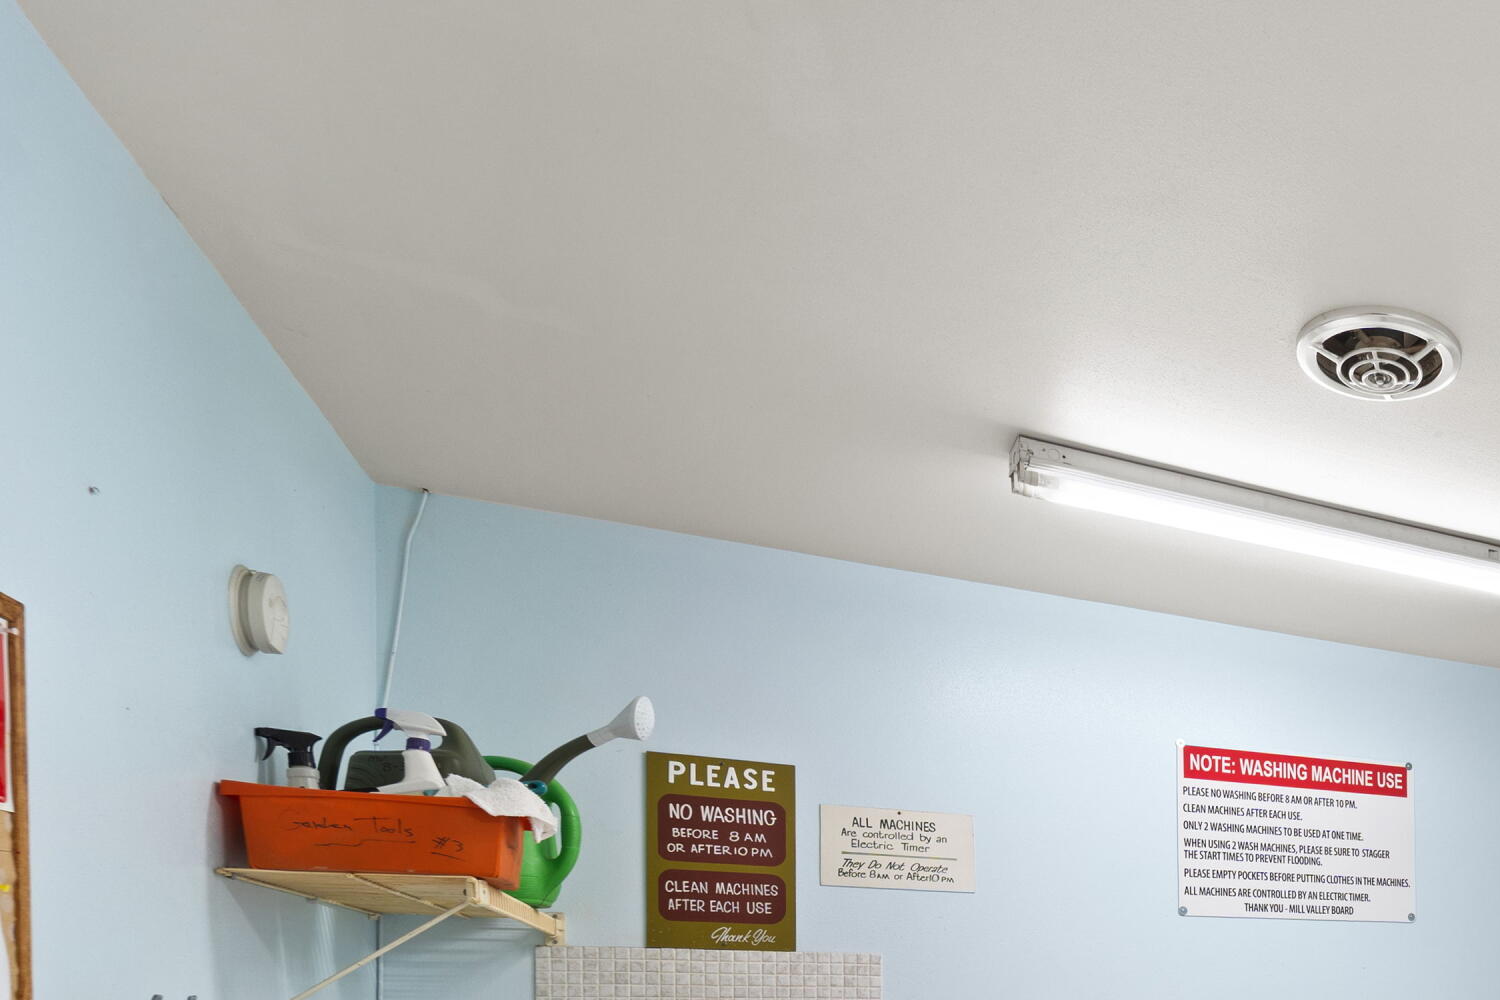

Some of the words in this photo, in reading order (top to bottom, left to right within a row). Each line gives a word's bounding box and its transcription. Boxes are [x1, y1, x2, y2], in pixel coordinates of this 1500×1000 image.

[668, 760, 776, 792] PLEASE
[1190, 753, 1235, 775] NOTE:
[1239, 758, 1308, 781] WASHING
[1311, 765, 1374, 787] MACHINE
[1377, 772, 1403, 789] USE
[1183, 786, 1209, 798] PLEASE
[1211, 789, 1222, 798] NO
[1222, 789, 1257, 801] WASHING
[1258, 792, 1284, 803] BEFORE
[1285, 795, 1290, 803] 8
[1291, 795, 1302, 804] AM
[1303, 796, 1313, 805] OR
[1314, 797, 1335, 807] AFTER
[1336, 799, 1344, 808] 10
[1345, 800, 1358, 809] PM.
[669, 803, 692, 820] NO
[700, 805, 777, 826] WASHING
[1183, 803, 1206, 814] CLEAN
[1208, 805, 1245, 816] MACHINES
[1246, 808, 1268, 818] AFTER
[1269, 810, 1287, 819] EACH
[1288, 811, 1303, 821] USE.
[852, 817, 872, 829] ALL
[880, 819, 936, 833] MACHINES
[1183, 820, 1203, 831] ONLY
[1204, 822, 1209, 831] 2
[1210, 822, 1245, 834] WASHING
[1246, 825, 1282, 836] MACHINES
[1284, 828, 1292, 837] TO
[1293, 828, 1302, 837] BE
[1303, 829, 1321, 839] USED
[1322, 830, 1331, 839] AT
[1331, 831, 1345, 840] ONE
[1346, 831, 1364, 841] TIME.
[672, 827, 719, 840] BEFORE
[729, 831, 740, 842] 8
[744, 833, 767, 843] AM
[841, 828, 857, 838] Are
[862, 831, 914, 841] controlled
[919, 834, 931, 844] by
[936, 836, 948, 844] an
[667, 843, 685, 853] OR
[691, 844, 732, 855] AFTER
[751, 848, 773, 858] PM
[851, 838, 894, 851] Electric
[901, 842, 930, 853] Timer
[1183, 838, 1207, 848] WHEN
[1208, 839, 1231, 850] USING
[1232, 841, 1237, 850] 2
[1237, 841, 1259, 851] WASH
[1260, 842, 1298, 854] MACHINES,
[1299, 845, 1323, 855] PLEASE
[1324, 846, 1333, 856] BE
[1334, 847, 1351, 857] SURE
[1352, 848, 1360, 857] TO
[1362, 848, 1390, 859] STAGGER
[842, 858, 866, 870] They
[868, 860, 882, 869] Do
[886, 861, 905, 871] Not
[910, 862, 949, 874] Operate
[1184, 849, 1198, 860] THE
[1200, 850, 1221, 861] START
[1222, 852, 1244, 862] TIMES
[1245, 853, 1254, 862] TO
[1255, 853, 1286, 864] PREVENT
[1287, 855, 1323, 866] FLOODING.
[838, 868, 866, 879] Before
[1184, 868, 1210, 879] PLEASE
[1212, 869, 1237, 879] EMPTY
[1238, 870, 1268, 881] POCKETS
[1269, 872, 1296, 882] BEFORE
[1296, 873, 1326, 884] PUTTING
[1326, 875, 1354, 885] CLOTHES
[1355, 876, 1363, 885] IN
[1363, 877, 1375, 886] THE
[1376, 878, 1411, 888] MACHINES.
[665, 880, 708, 894] CLEAN
[715, 882, 778, 896] MACHINES
[1184, 886, 1197, 896] ALL
[1199, 887, 1237, 897] MACHINES
[1237, 888, 1251, 898] ARE
[1252, 889, 1297, 900] CONTROLLED
[1298, 891, 1307, 900] BY
[1308, 891, 1318, 900] AN
[1319, 892, 1348, 901] ELECTRIC
[1349, 893, 1371, 902] TIMER.
[668, 898, 705, 912] AFTER
[710, 900, 740, 913] EACH
[747, 902, 772, 915] USE
[1244, 903, 1269, 912] THANK
[1269, 904, 1284, 913] YOU
[1289, 905, 1305, 914] MILL
[1306, 905, 1331, 915] VALLEY
[1331, 906, 1354, 915] BOARD
[711, 926, 751, 943] Thank
[751, 928, 776, 946] You
